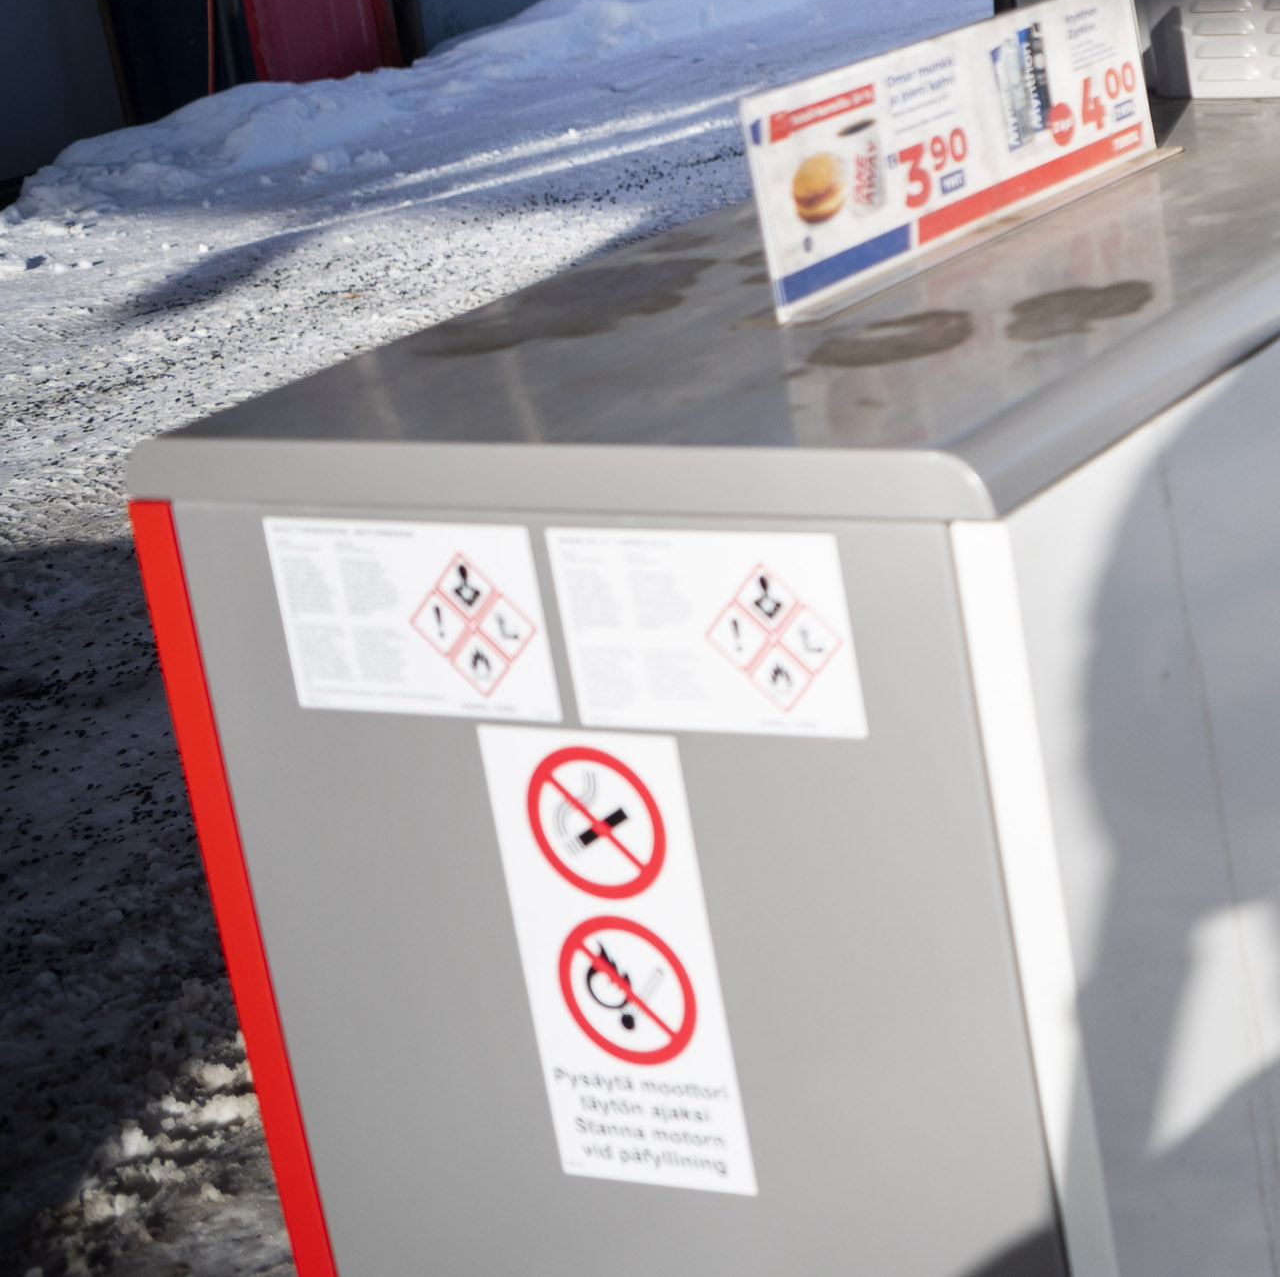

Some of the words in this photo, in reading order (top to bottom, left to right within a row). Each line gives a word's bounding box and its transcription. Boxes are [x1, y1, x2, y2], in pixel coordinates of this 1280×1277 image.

[553, 1066, 634, 1094] Pysäytä
[640, 1079, 729, 1101] moottori
[580, 1095, 643, 1116] täytön
[651, 1105, 711, 1123] ajaksi
[575, 1116, 645, 1140] Stanna
[652, 1129, 726, 1148] motorn
[582, 1145, 613, 1161] vid
